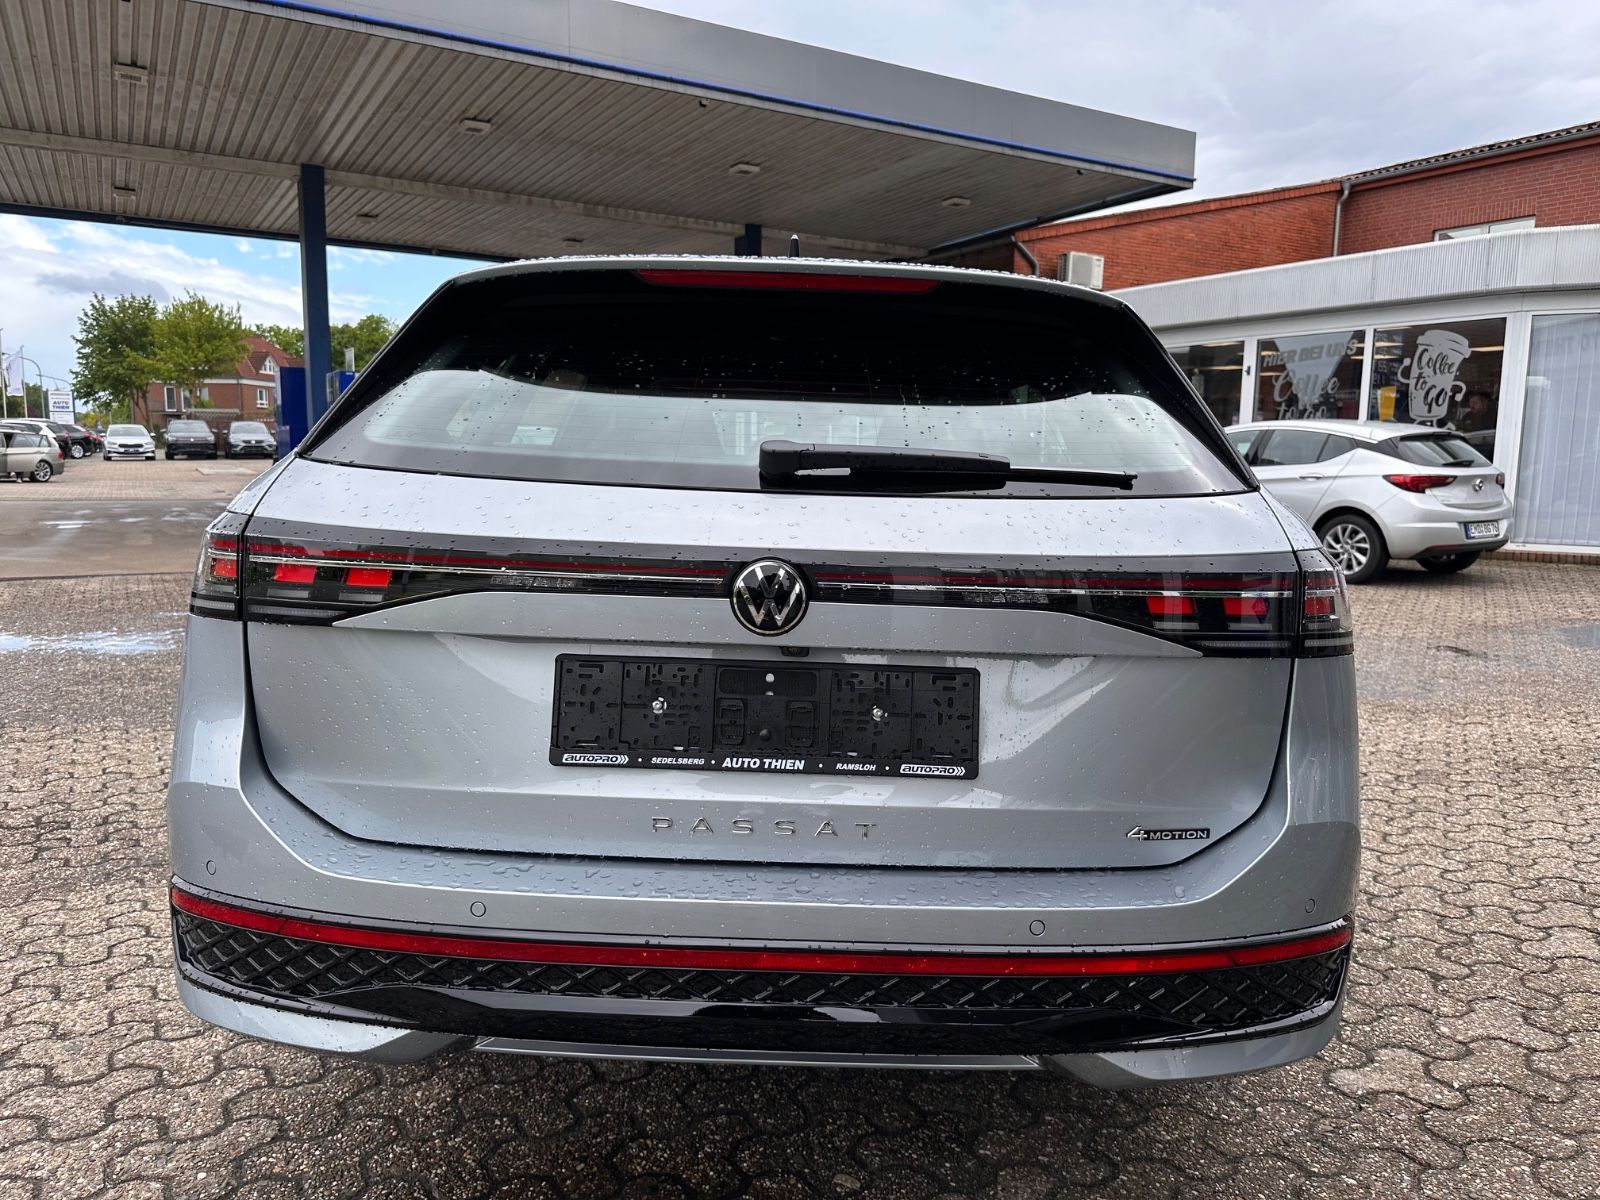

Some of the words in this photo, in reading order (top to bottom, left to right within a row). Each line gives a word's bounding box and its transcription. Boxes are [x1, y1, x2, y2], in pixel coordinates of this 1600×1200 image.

[651, 757, 705, 765] SEDELSBERG
[722, 758, 759, 769] AUTO
[762, 759, 805, 770] THIEN
[836, 763, 876, 771] RAMSLOH
[651, 816, 877, 839] PASSAT
